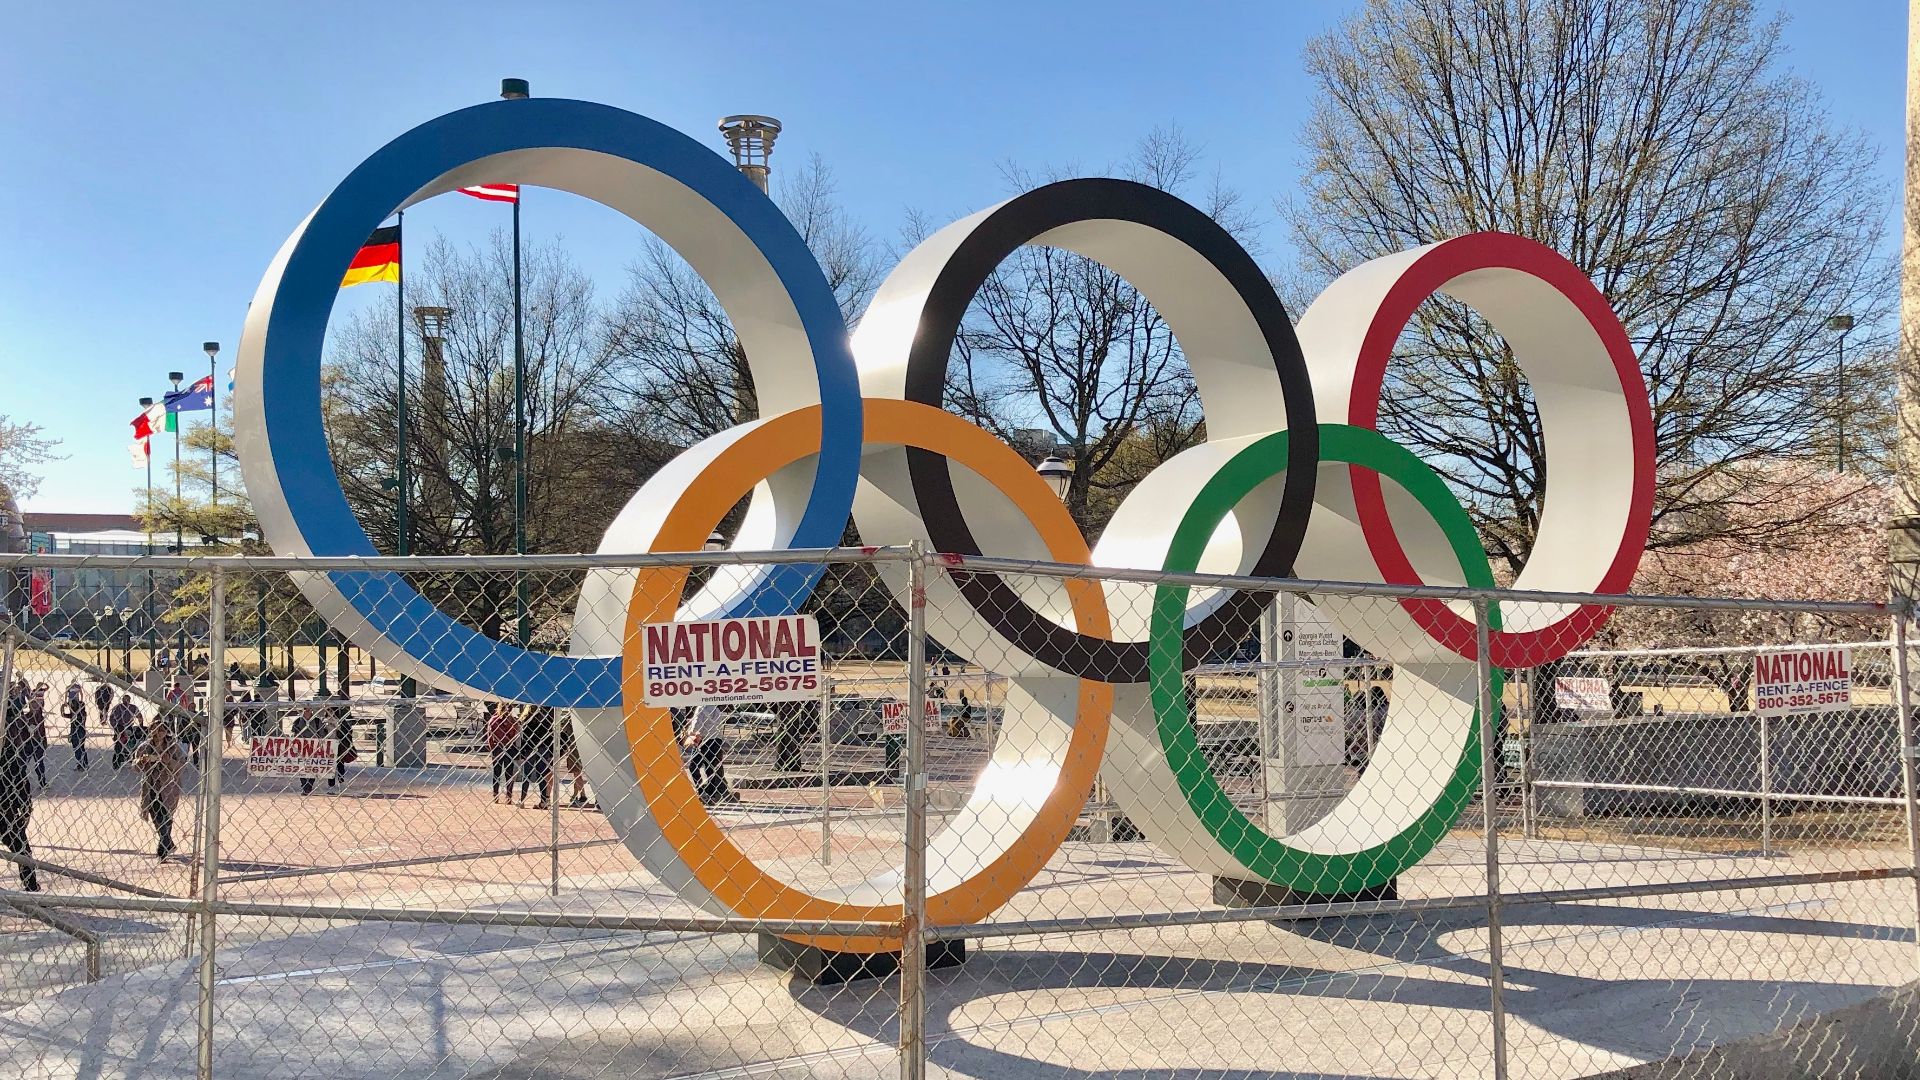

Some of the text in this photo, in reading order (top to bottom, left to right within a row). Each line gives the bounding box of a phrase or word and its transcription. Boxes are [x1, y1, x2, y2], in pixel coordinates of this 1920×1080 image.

[647, 618, 816, 664] NATIONAL
[648, 659, 816, 680] RENT-A-FENCE
[1755, 651, 1848, 685] NATIONAL
[650, 675, 817, 697] 800-352-5675
[1757, 680, 1848, 696] RENT-A-FENCE
[701, 694, 763, 702] rentnational.com
[1758, 692, 1849, 709] 800-352-5675
[252, 737, 334, 758] NATIONAL
